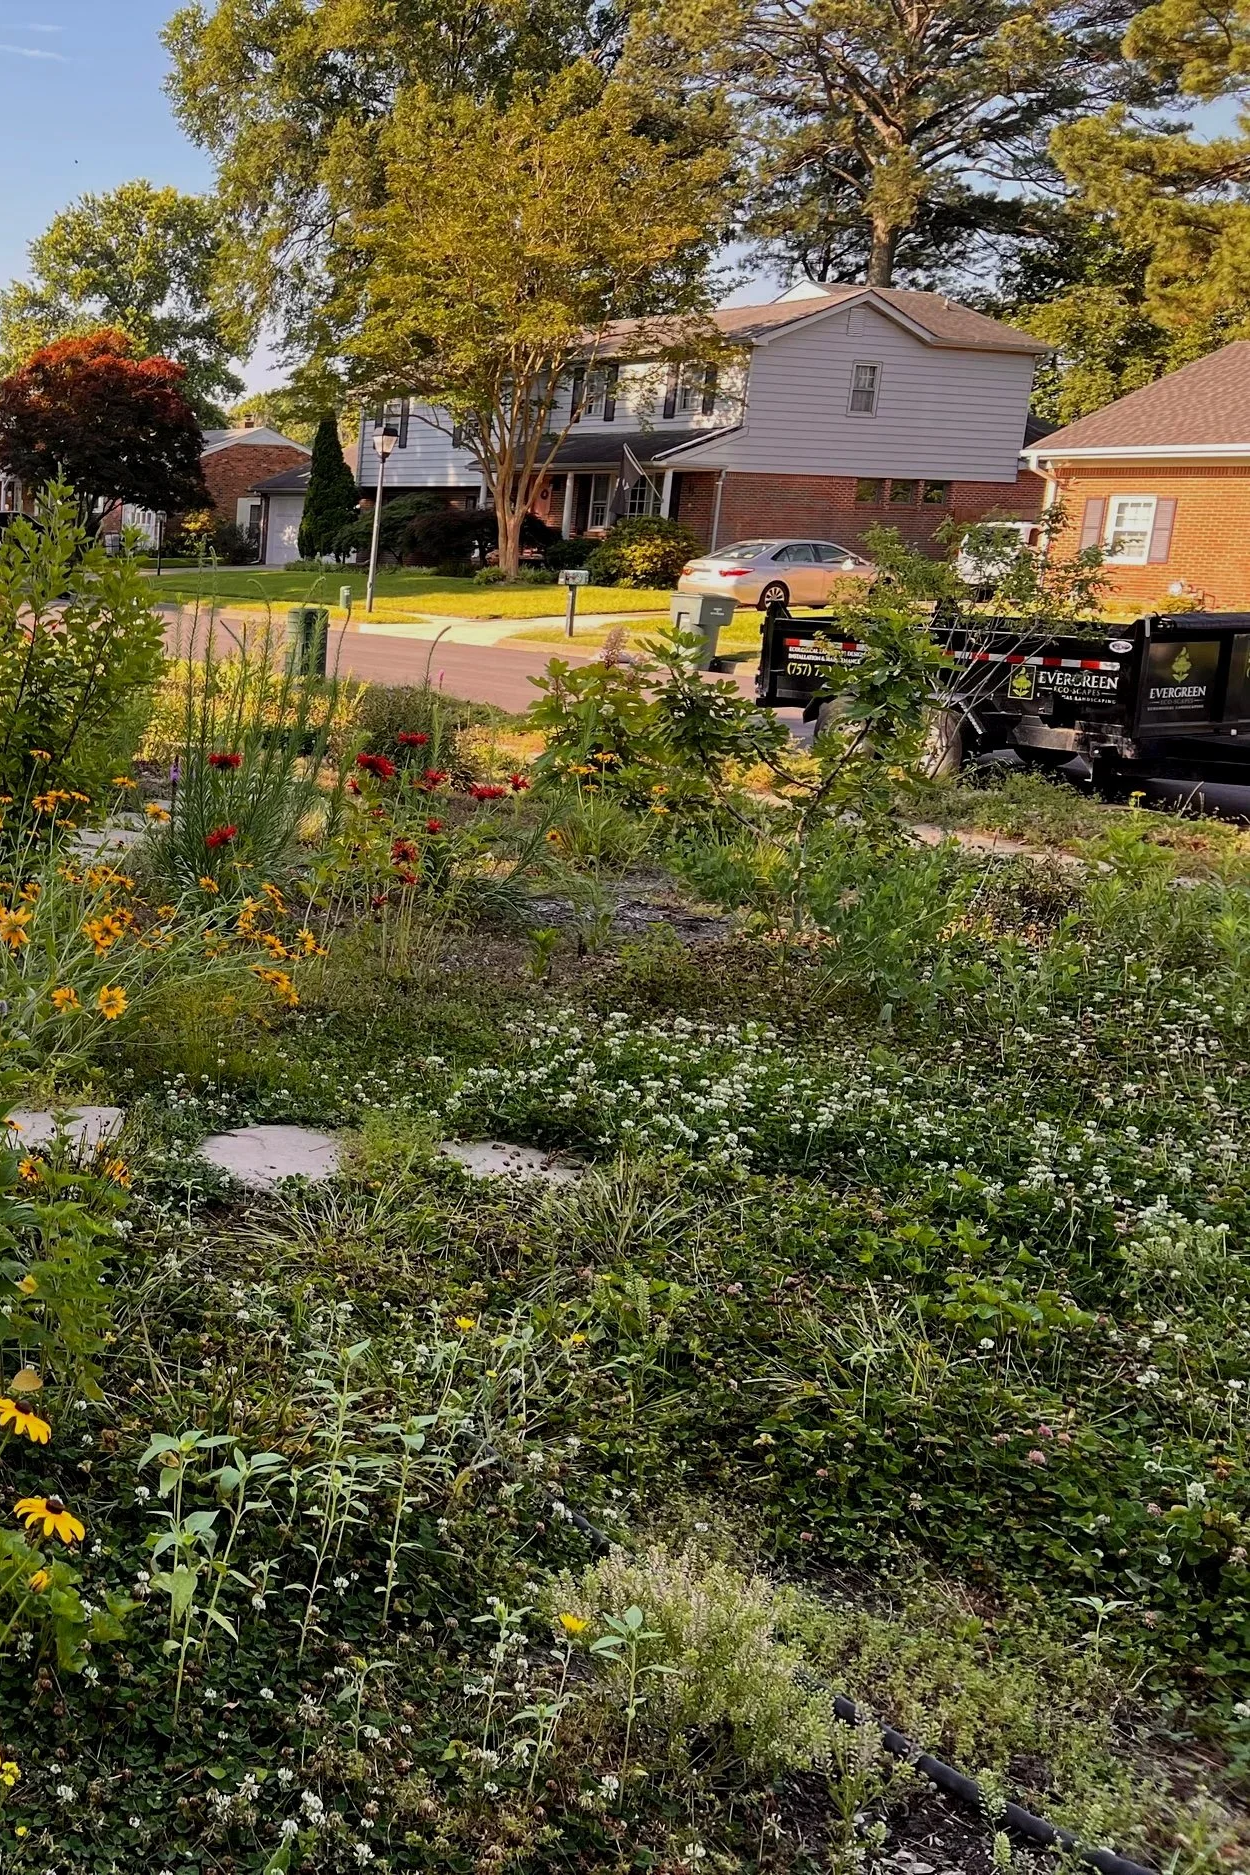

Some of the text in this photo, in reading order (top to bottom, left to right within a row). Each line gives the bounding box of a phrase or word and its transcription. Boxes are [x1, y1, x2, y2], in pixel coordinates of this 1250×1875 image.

[788, 653, 821, 661] INSTALLATION
[787, 662, 812, 677] (757)
[1038, 671, 1120, 690] EVERGREEN
[1149, 686, 1207, 699] EVERGREEN
[1074, 696, 1116, 705] LANDSCAPING
